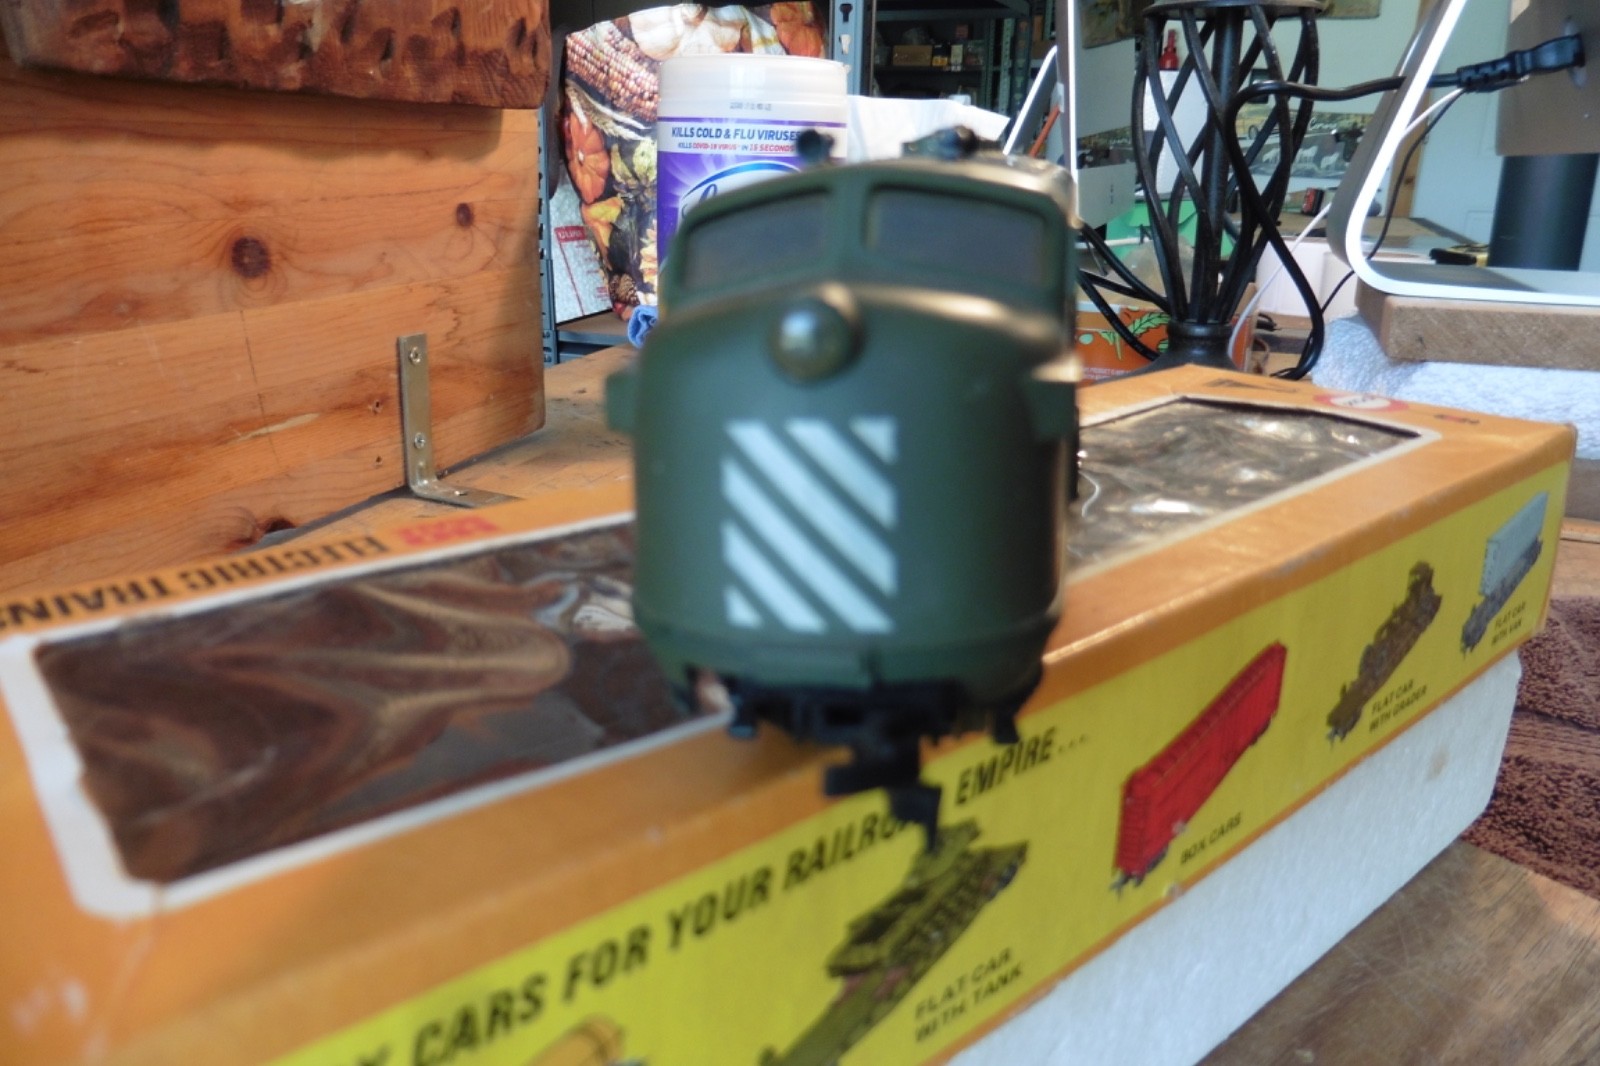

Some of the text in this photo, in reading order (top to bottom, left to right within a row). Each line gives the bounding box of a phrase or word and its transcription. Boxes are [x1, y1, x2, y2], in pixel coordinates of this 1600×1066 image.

[671, 127, 695, 138] KILLS
[696, 127, 722, 139] COLD
[724, 129, 731, 139] &
[733, 129, 755, 140] FLU
[0, 576, 170, 629] TRAIN
[1180, 811, 1242, 867] BOX CARS
[412, 973, 548, 1066] CARS
[562, 923, 652, 1004] FOR
[667, 865, 773, 952] YOUR
[915, 946, 1013, 1021] FLAT CAR
[973, 962, 1022, 1005] TANK
